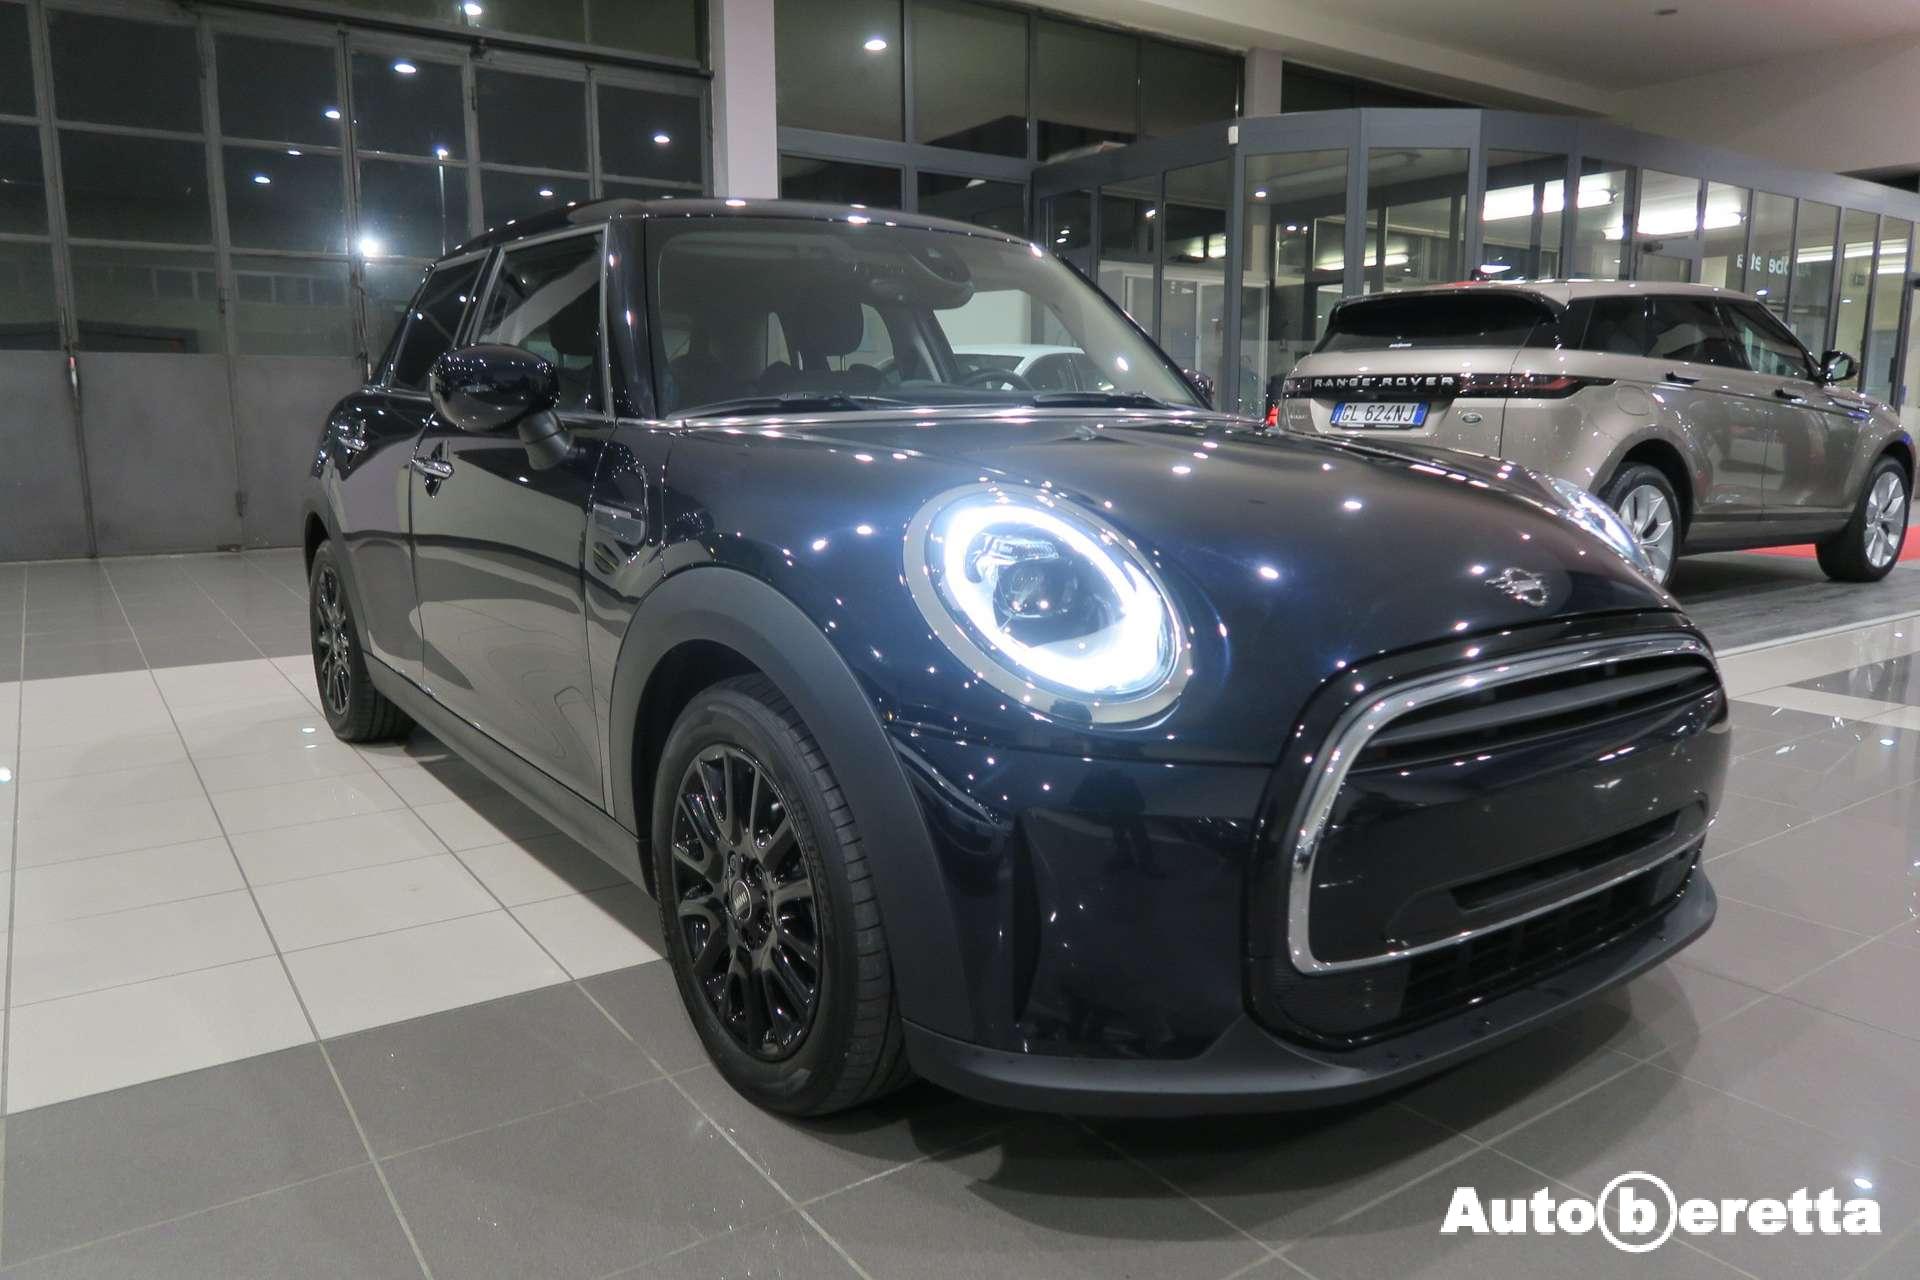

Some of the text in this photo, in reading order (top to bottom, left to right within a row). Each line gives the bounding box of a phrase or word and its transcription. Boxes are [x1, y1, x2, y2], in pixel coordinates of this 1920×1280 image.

[1314, 375, 1455, 388] RANGE ROVER
[1342, 404, 1416, 422] GL 624NJ
